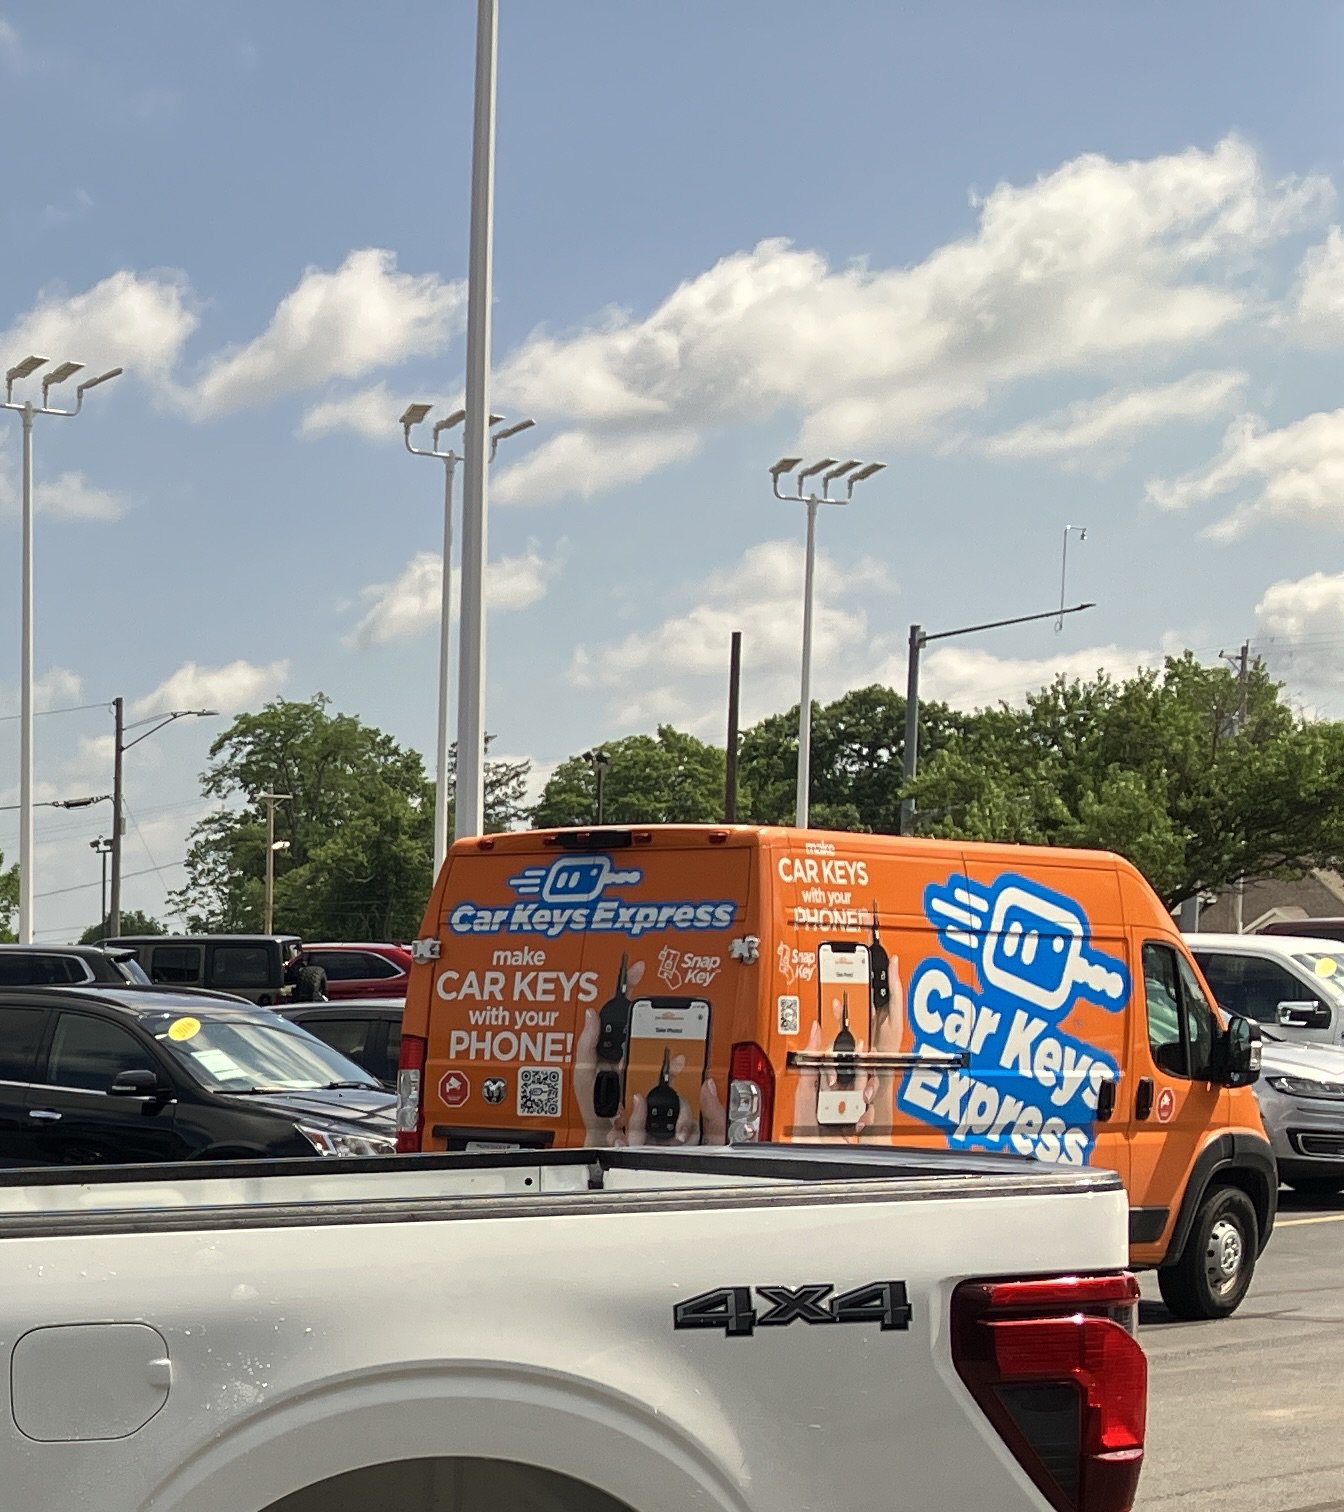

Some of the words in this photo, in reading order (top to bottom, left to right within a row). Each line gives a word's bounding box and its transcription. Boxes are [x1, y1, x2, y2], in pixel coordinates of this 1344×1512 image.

[778, 857, 820, 884] CAR
[821, 859, 869, 886] KEYS
[801, 887, 826, 904] with
[827, 890, 852, 907] your
[451, 904, 509, 932] Car
[509, 903, 590, 936] Keys
[591, 901, 734, 935] Express
[492, 946, 546, 966] make
[681, 953, 721, 971] Snap
[791, 949, 816, 965] Snap
[684, 968, 721, 987] Key
[794, 963, 817, 982] Key
[436, 971, 506, 1001] CAR
[512, 971, 599, 1002] KEYS
[469, 1006, 510, 1026] with
[514, 1010, 560, 1030] your
[449, 1030, 574, 1063] PHONE!
[913, 969, 1002, 1055] Car
[999, 1008, 1115, 1110] Keys
[903, 1043, 1088, 1167] Express
